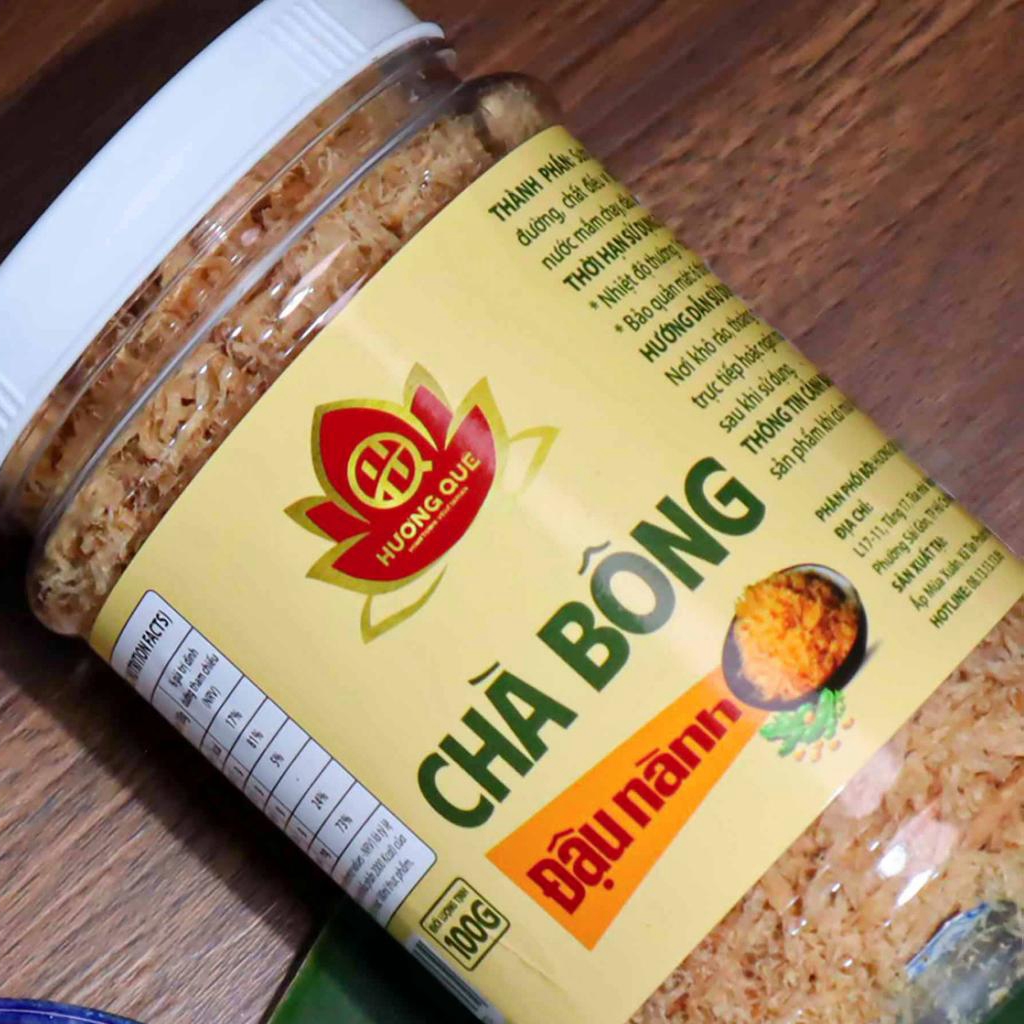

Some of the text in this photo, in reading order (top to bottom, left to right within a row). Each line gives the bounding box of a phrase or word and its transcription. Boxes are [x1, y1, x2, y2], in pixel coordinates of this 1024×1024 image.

[488, 176, 543, 222] THÀNH
[516, 207, 566, 246] đường,
[541, 237, 579, 270] nước
[562, 255, 605, 291] THỜI
[596, 234, 631, 264] HẠN
[597, 273, 639, 309] Nhiệt
[632, 260, 652, 280] độ
[622, 306, 654, 332] Bảo
[650, 284, 681, 311] quản
[639, 312, 695, 363] HƯỚNG
[664, 357, 695, 386] Nơi
[686, 338, 717, 365] khô
[691, 381, 724, 409] trực
[715, 362, 745, 386] tiếp
[719, 407, 746, 433] sau
[736, 387, 763, 412] khi
[740, 406, 793, 454] THÔNG
[783, 392, 809, 414] TIN
[769, 454, 796, 480] sản
[373, 490, 444, 567] HƯƠNG
[142, 610, 172, 647] FACTS)
[929, 586, 972, 628] HOTLINE:
[418, 457, 765, 828] CHÀ BÔNG
[226, 710, 243, 729] 17%
[270, 753, 285, 768] 5%
[311, 791, 329, 811] 24%
[334, 814, 353, 834] 73%
[526, 699, 742, 915] Đậu nành
[444, 900, 500, 960] 100G
